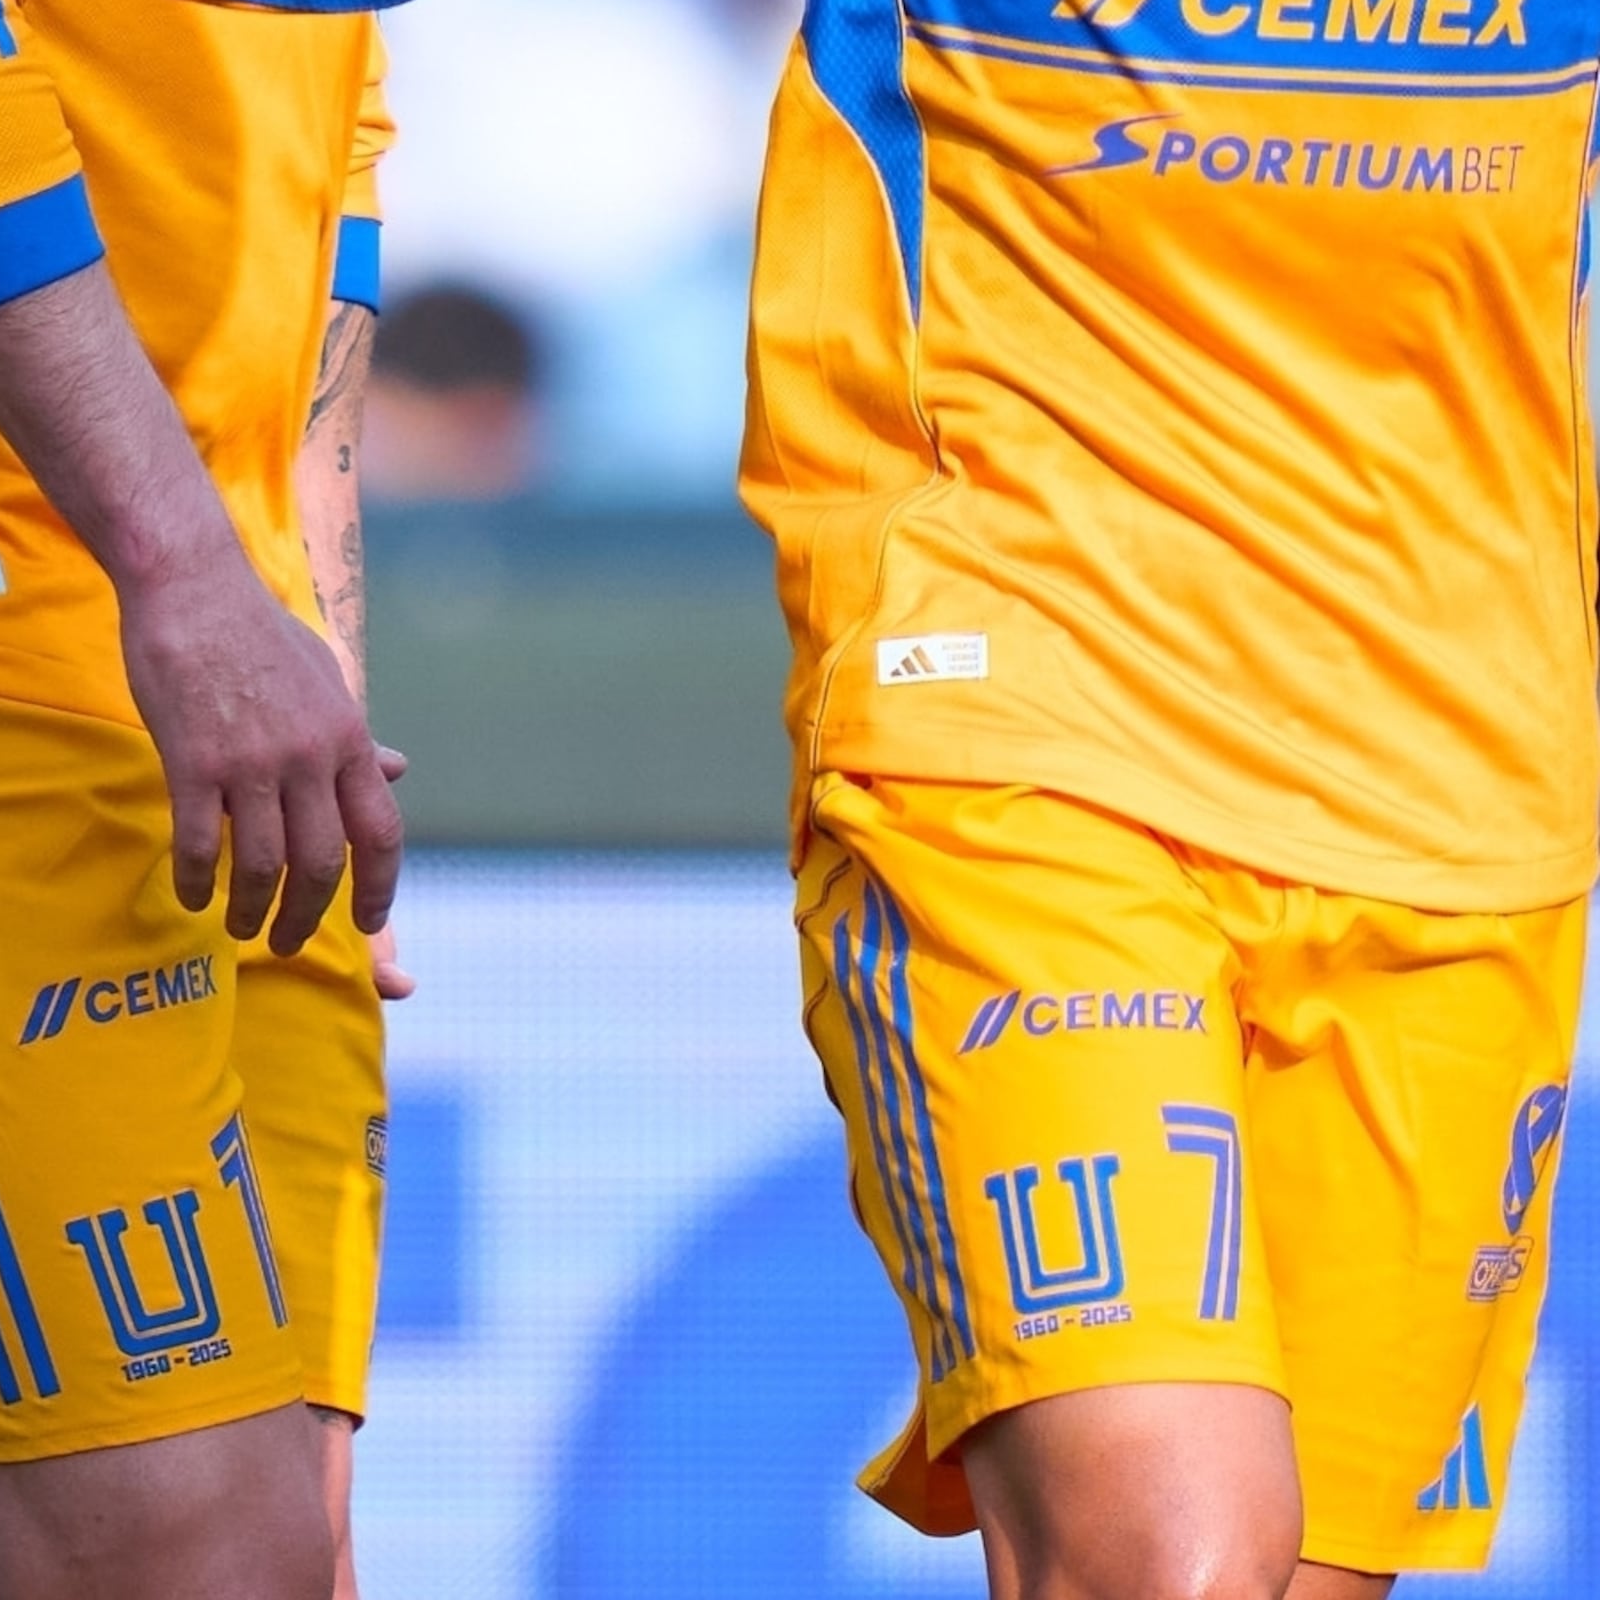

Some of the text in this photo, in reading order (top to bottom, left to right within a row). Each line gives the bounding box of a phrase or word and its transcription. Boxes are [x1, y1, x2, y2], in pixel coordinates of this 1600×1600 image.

[85, 955, 218, 1024] CEMEX
[1022, 993, 1208, 1036] CEMEX
[983, 1154, 1125, 1316] U
[1161, 1103, 1242, 1322] 7
[64, 1188, 222, 1357] U
[1014, 1315, 1060, 1343] 1960
[1080, 1305, 1132, 1327] 2025
[120, 1355, 171, 1383] 1960
[188, 1338, 233, 1367] 2025
